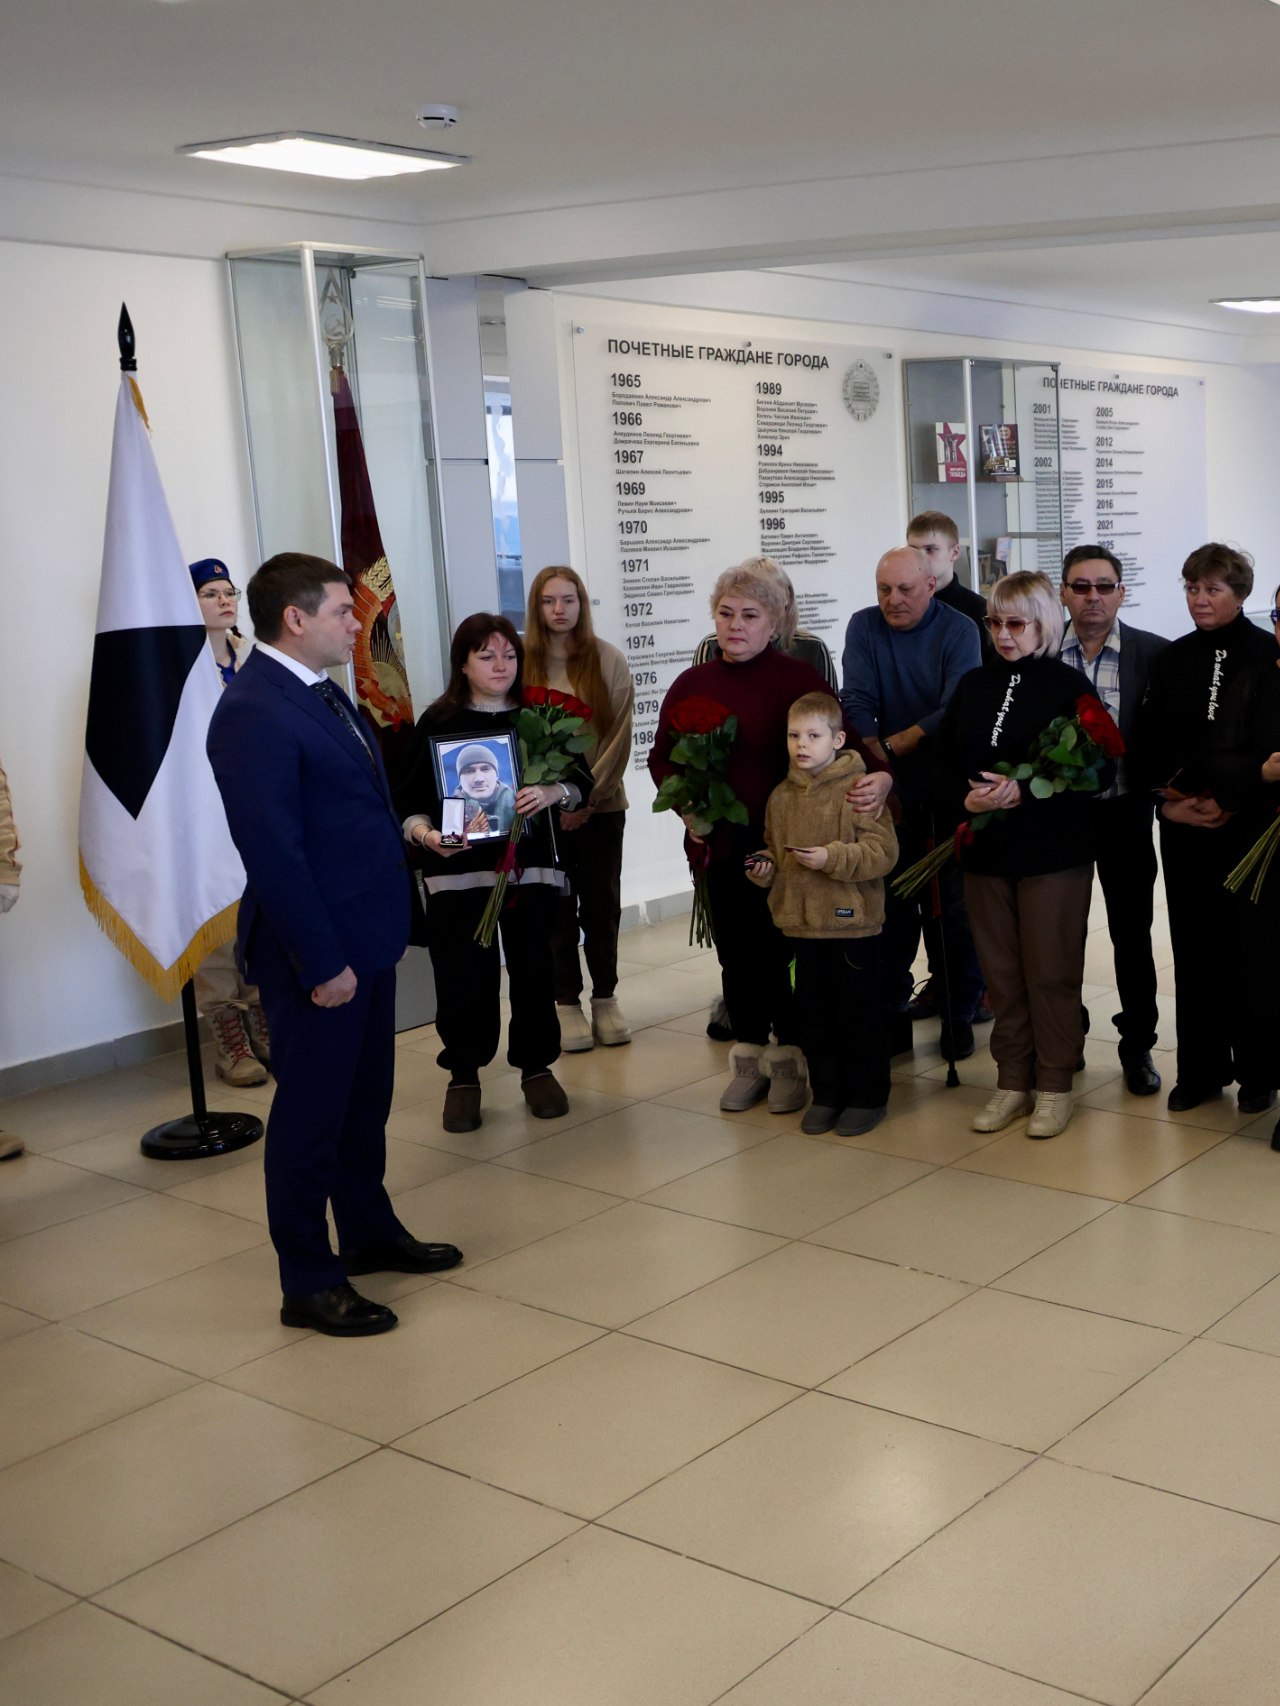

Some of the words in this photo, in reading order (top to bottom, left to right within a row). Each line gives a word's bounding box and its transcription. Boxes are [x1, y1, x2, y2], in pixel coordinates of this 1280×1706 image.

[608, 339, 694, 359] ПОЧЕТНЫЕ
[699, 346, 773, 365] ГРАЖДАНЕ
[777, 352, 829, 370] ГОРОДА
[611, 373, 641, 388] 1965
[756, 382, 782, 395] 1989
[1098, 381, 1144, 395] ГРАЖДАНЕ
[1146, 385, 1179, 398] ГОРОДА
[1033, 403, 1051, 414] 2001
[1096, 406, 1113, 417] 2005
[612, 412, 642, 425] 1966
[1096, 436, 1113, 447] 2012
[614, 450, 644, 463] 1967
[757, 444, 783, 457] 1994
[1034, 457, 1052, 467] 2002
[1096, 457, 1113, 467] 2014
[616, 482, 646, 495] 1969
[1096, 479, 1113, 489] 2015
[759, 491, 785, 503] 1995
[1096, 499, 1113, 509] 2016
[619, 520, 648, 534] 1970
[760, 518, 785, 530] 1996
[1097, 520, 1113, 530] 2021
[621, 559, 649, 572] 1971
[624, 602, 653, 617] 1972
[626, 634, 655, 650] 1974
[1215, 649, 1227, 662] Do
[1009, 673, 1021, 687] Do
[1212, 662, 1224, 686] what
[1001, 687, 1014, 712] what
[1208, 686, 1218, 701] you
[632, 699, 659, 715] 1979
[1207, 701, 1219, 721] love
[995, 711, 1006, 727] you
[633, 730, 654, 745] 198
[991, 726, 1003, 747] love
